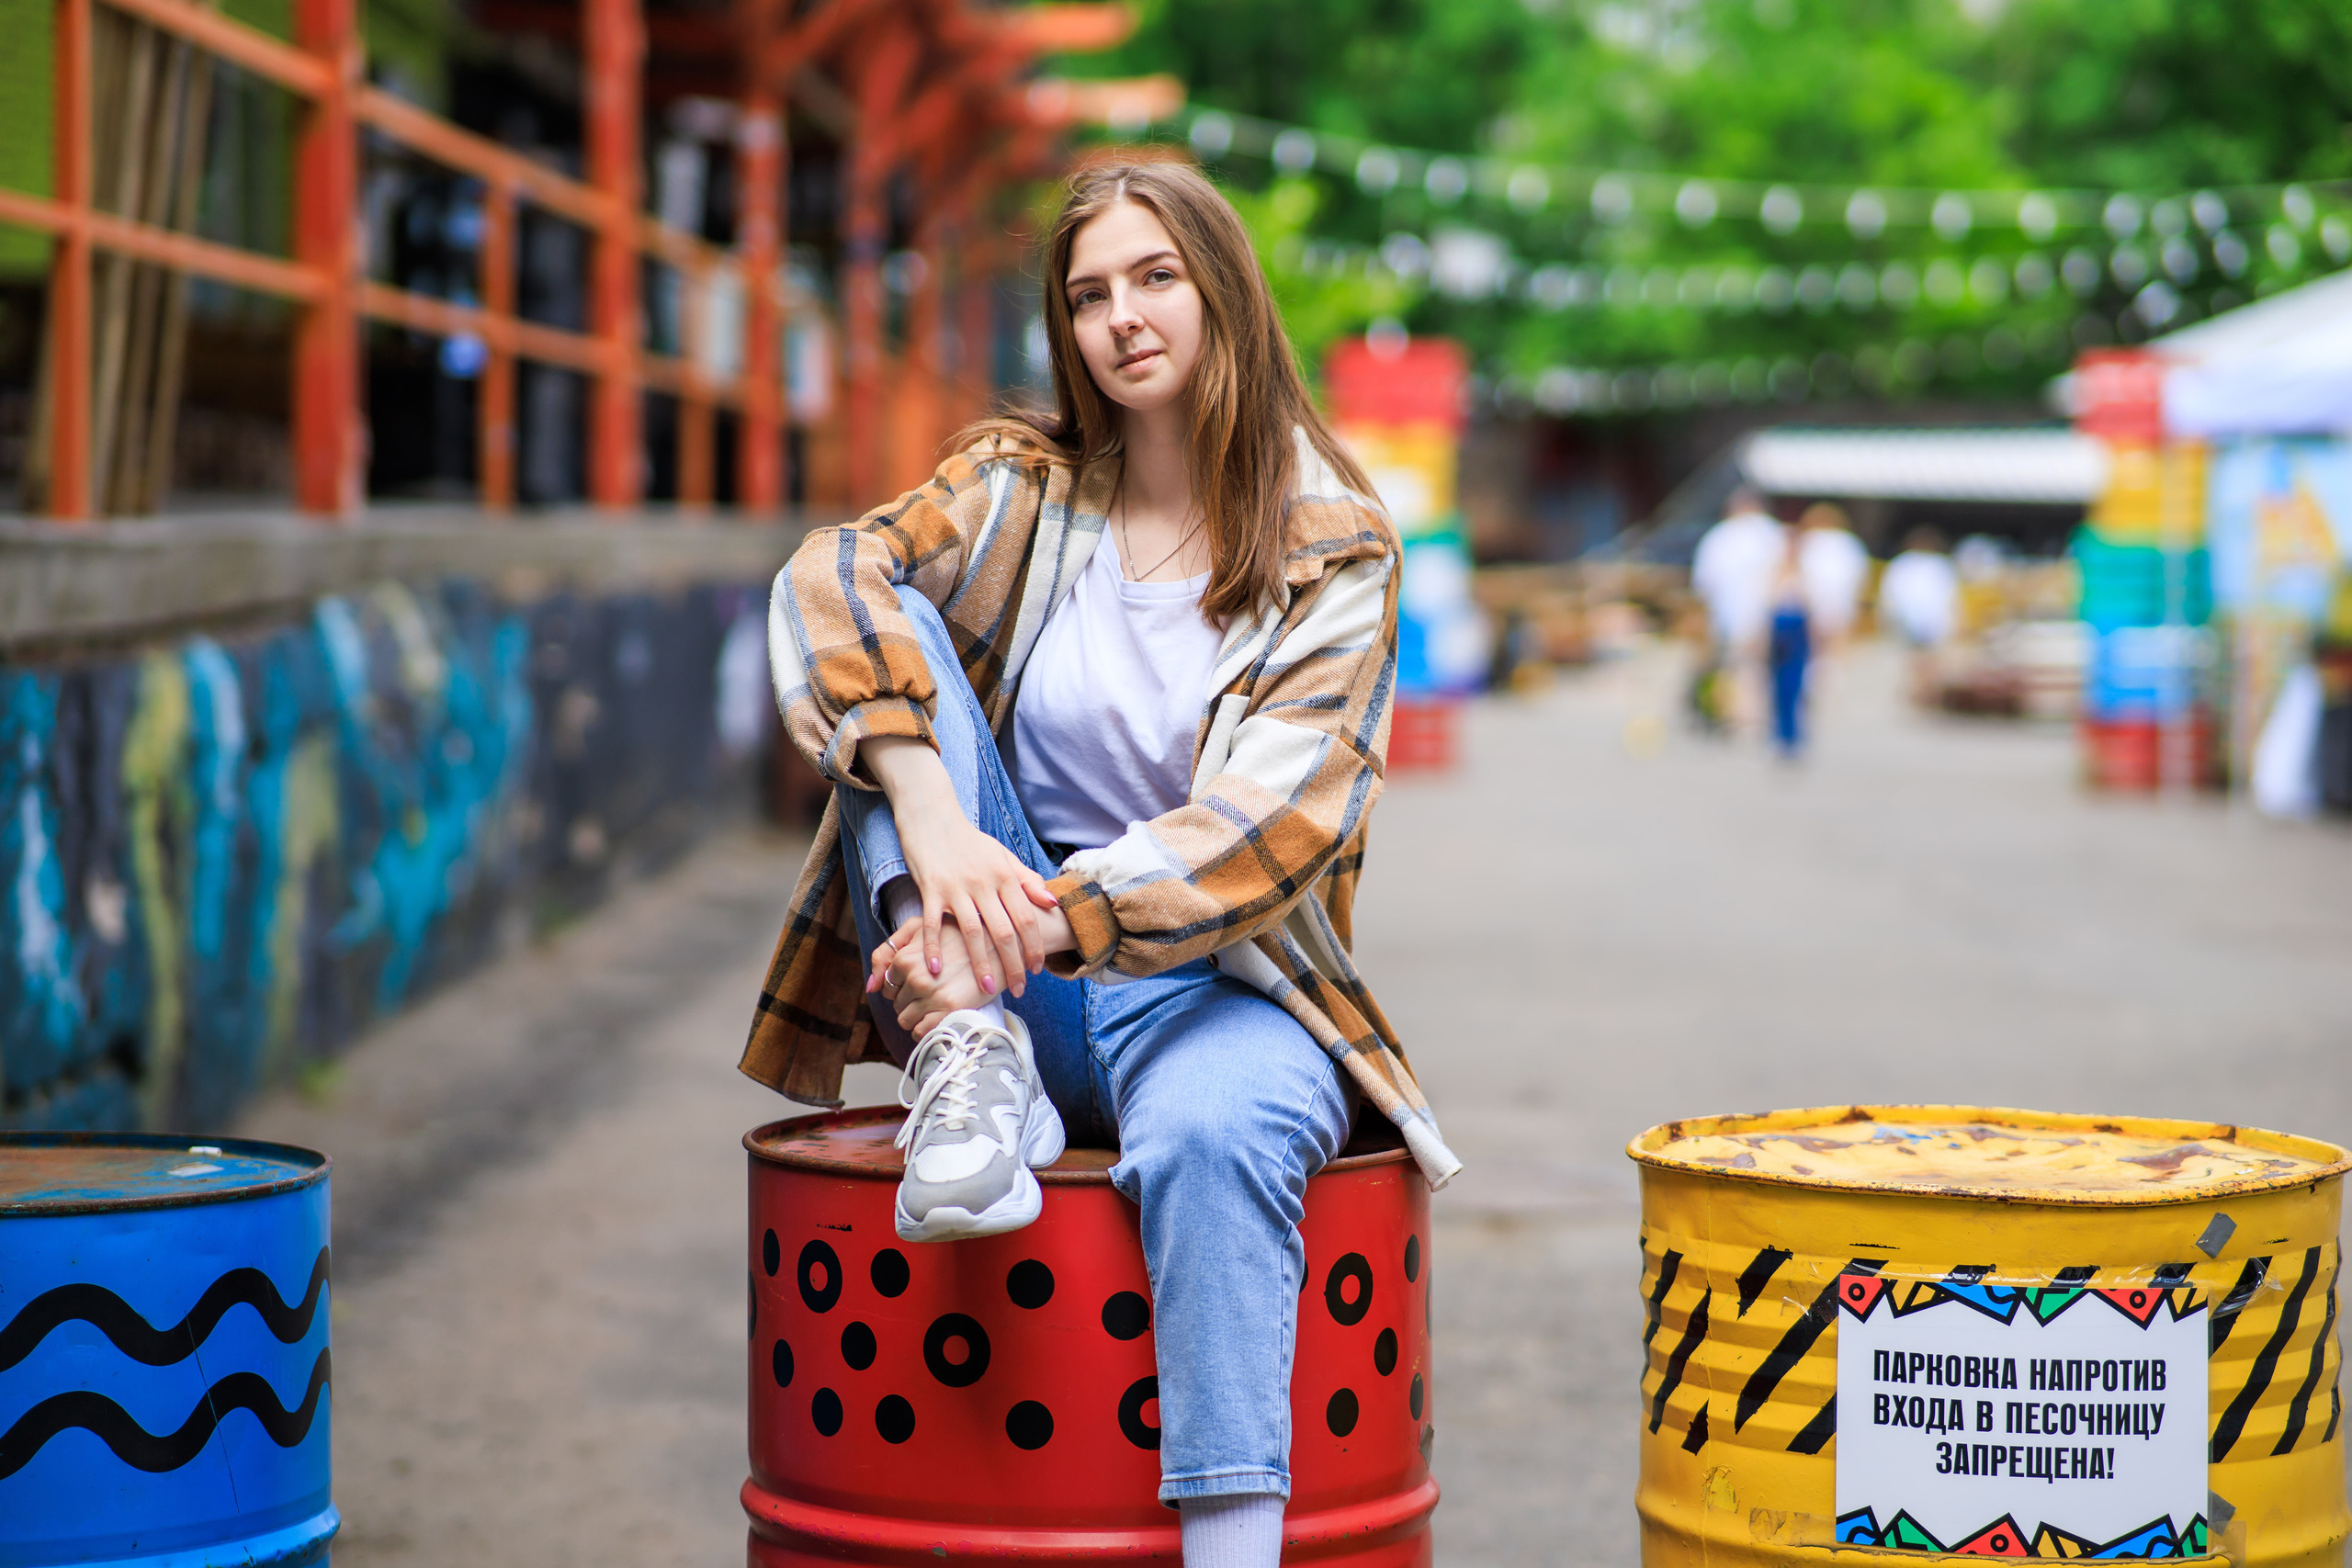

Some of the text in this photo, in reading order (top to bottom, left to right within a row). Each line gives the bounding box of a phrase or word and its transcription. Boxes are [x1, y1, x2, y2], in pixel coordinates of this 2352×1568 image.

[1873, 1349, 2166, 1392] ПАРКОВКА НАПРОТИВ
[1873, 1393, 2165, 1441] ВХОДА В ПЕСОЧНИЦУ
[1936, 1441, 2115, 1484] ЗАПРЕЩЕНА!
